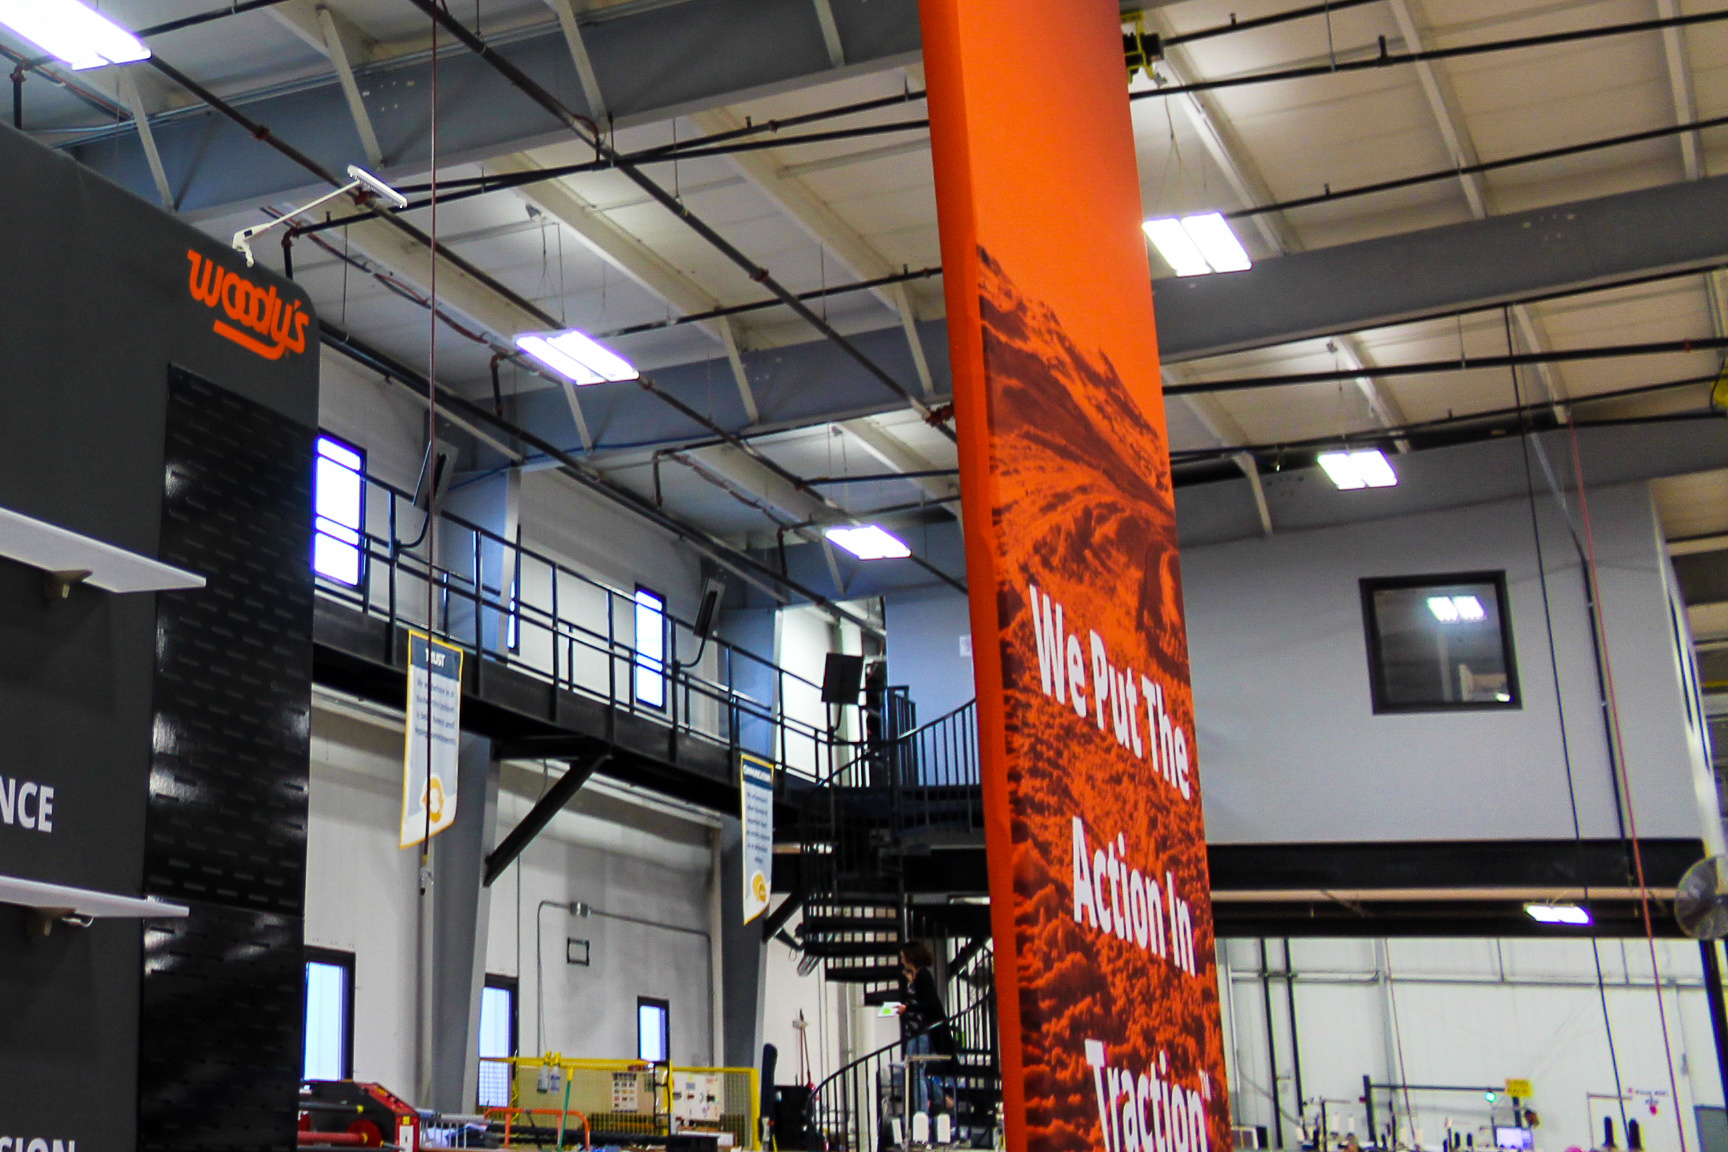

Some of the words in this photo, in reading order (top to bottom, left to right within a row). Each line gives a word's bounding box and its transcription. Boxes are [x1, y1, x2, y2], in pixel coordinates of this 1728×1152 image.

[1030, 584, 1087, 718] We
[1090, 629, 1142, 759] Put
[1142, 674, 1190, 800] The
[1073, 816, 1167, 959] Action
[1166, 870, 1196, 977] In
